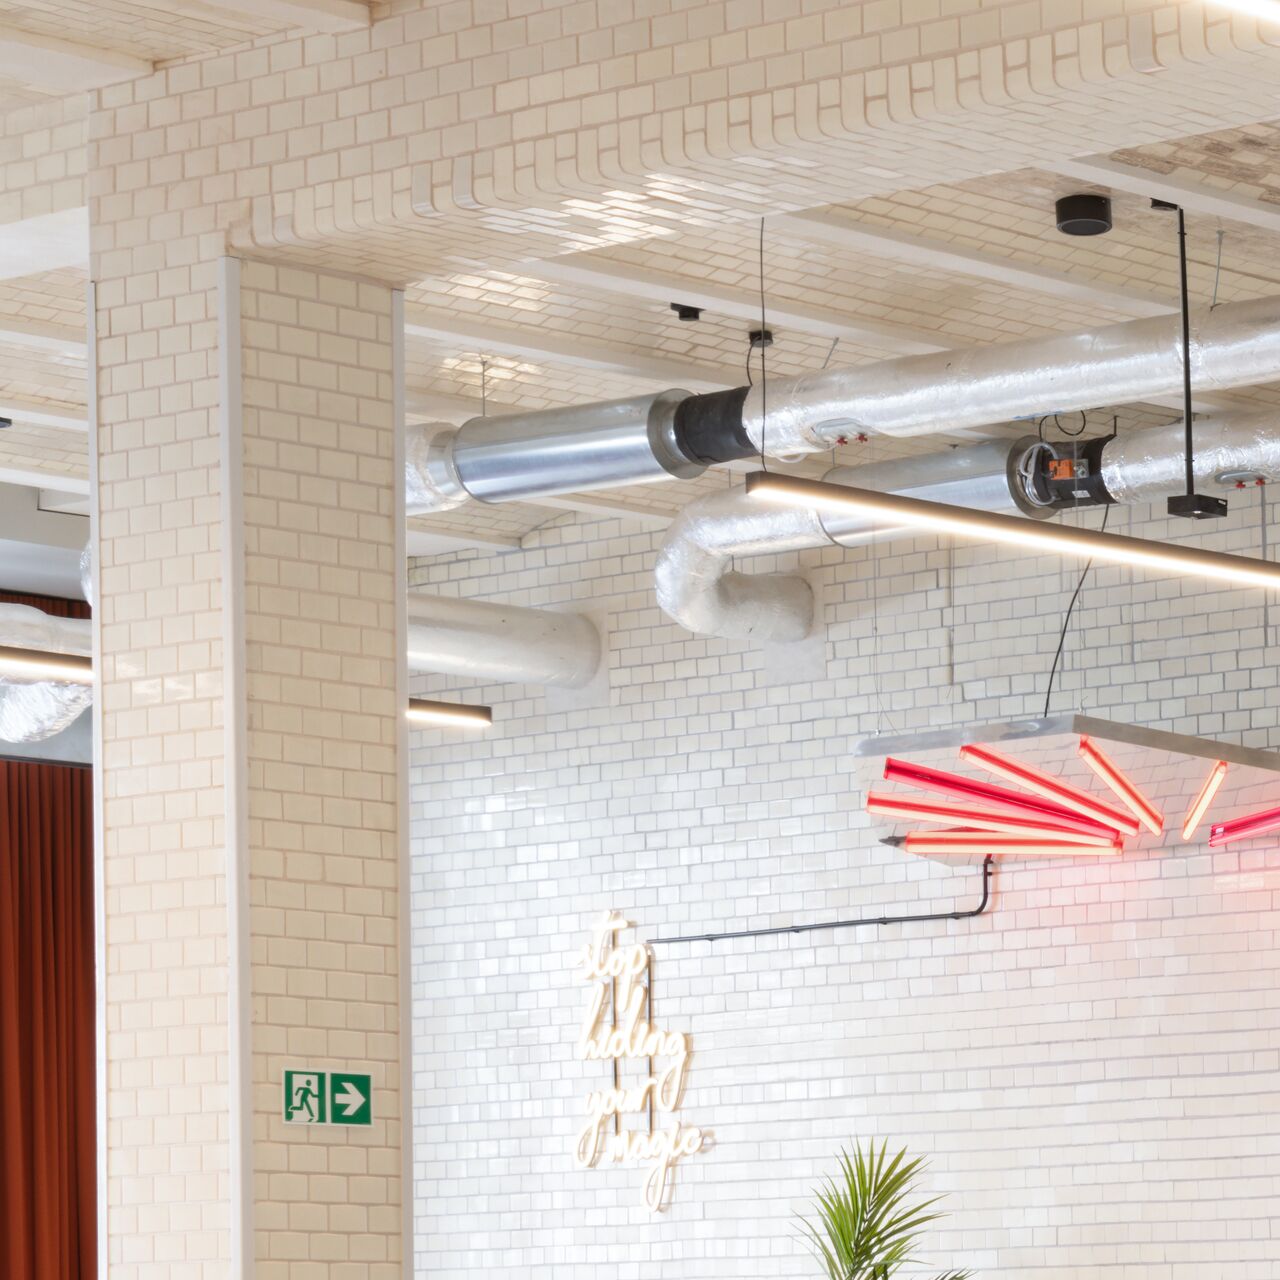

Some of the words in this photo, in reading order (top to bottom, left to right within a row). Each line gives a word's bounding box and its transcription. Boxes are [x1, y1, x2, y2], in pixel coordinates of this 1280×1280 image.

[575, 910, 649, 1012] stop
[578, 980, 688, 1112] hiding
[574, 1078, 657, 1168] your
[607, 1121, 703, 1213] magic
